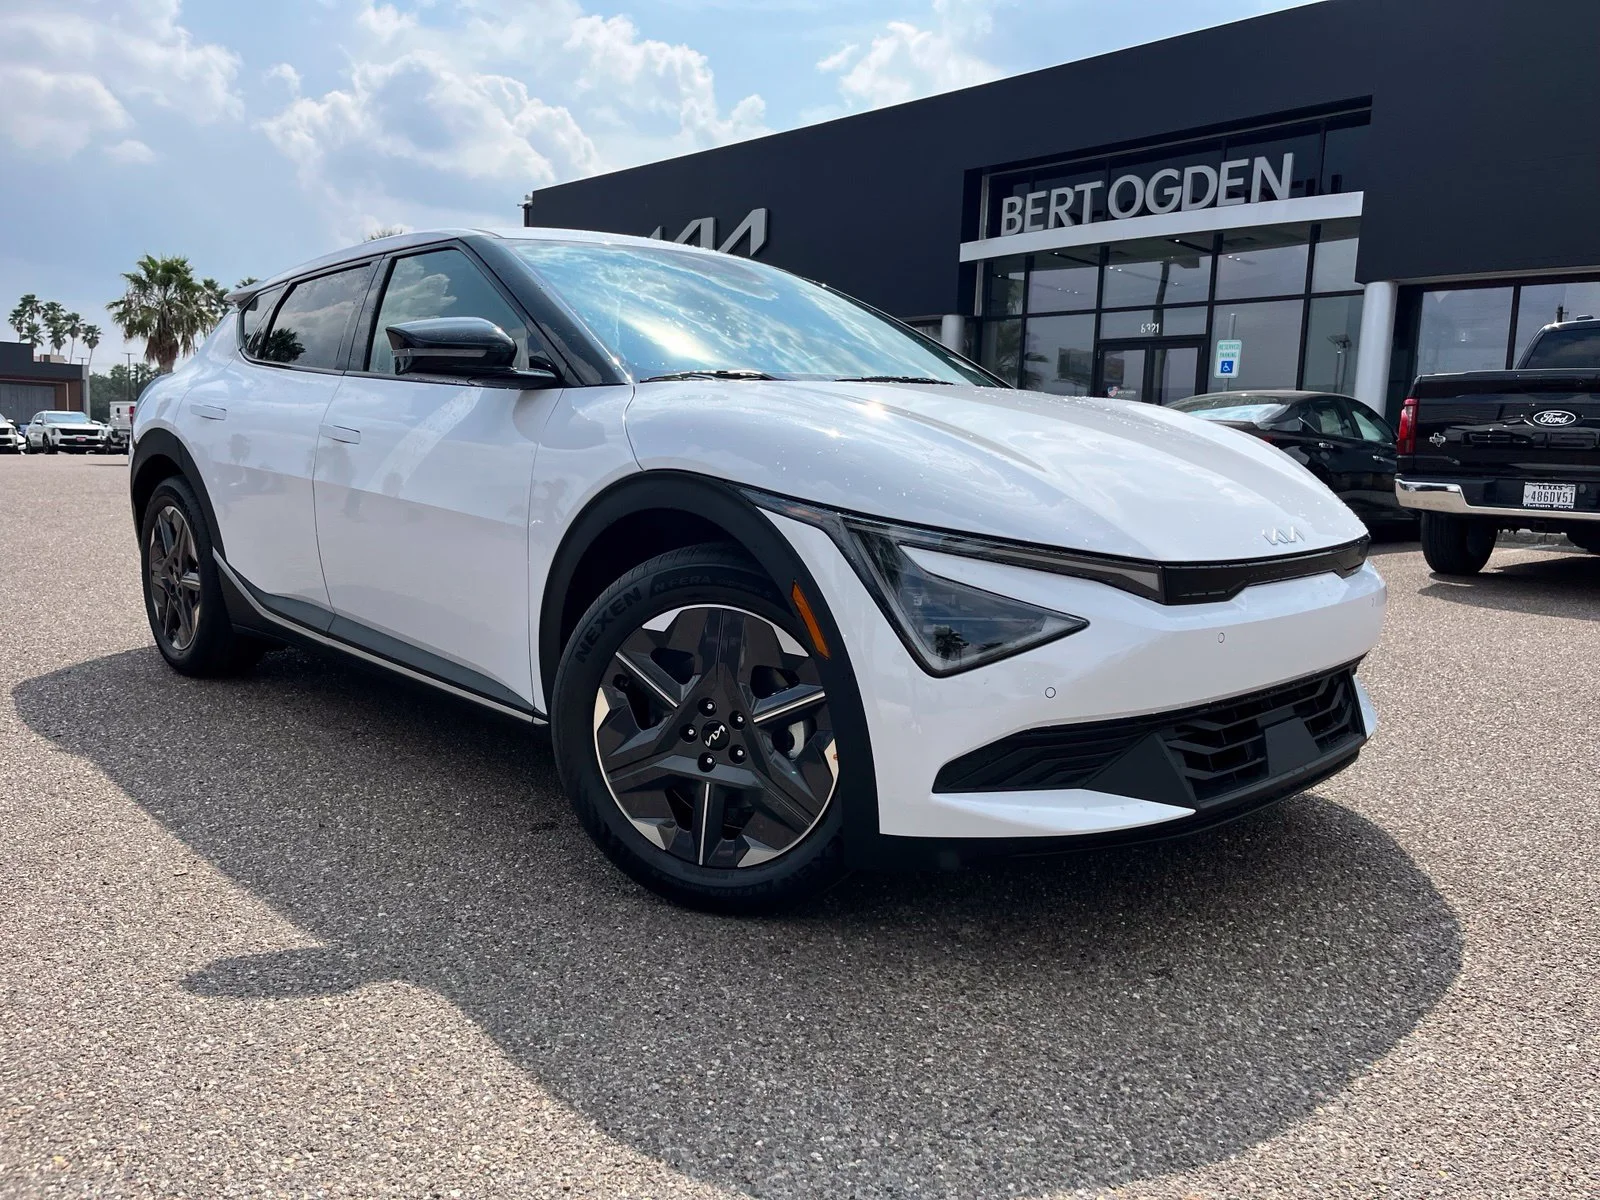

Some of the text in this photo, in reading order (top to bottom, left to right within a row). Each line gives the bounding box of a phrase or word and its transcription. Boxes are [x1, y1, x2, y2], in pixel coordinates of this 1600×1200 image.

[1001, 152, 1295, 237] BERT OGDEN
[1539, 411, 1570, 425] Ford
[575, 586, 643, 664] NEXEN
